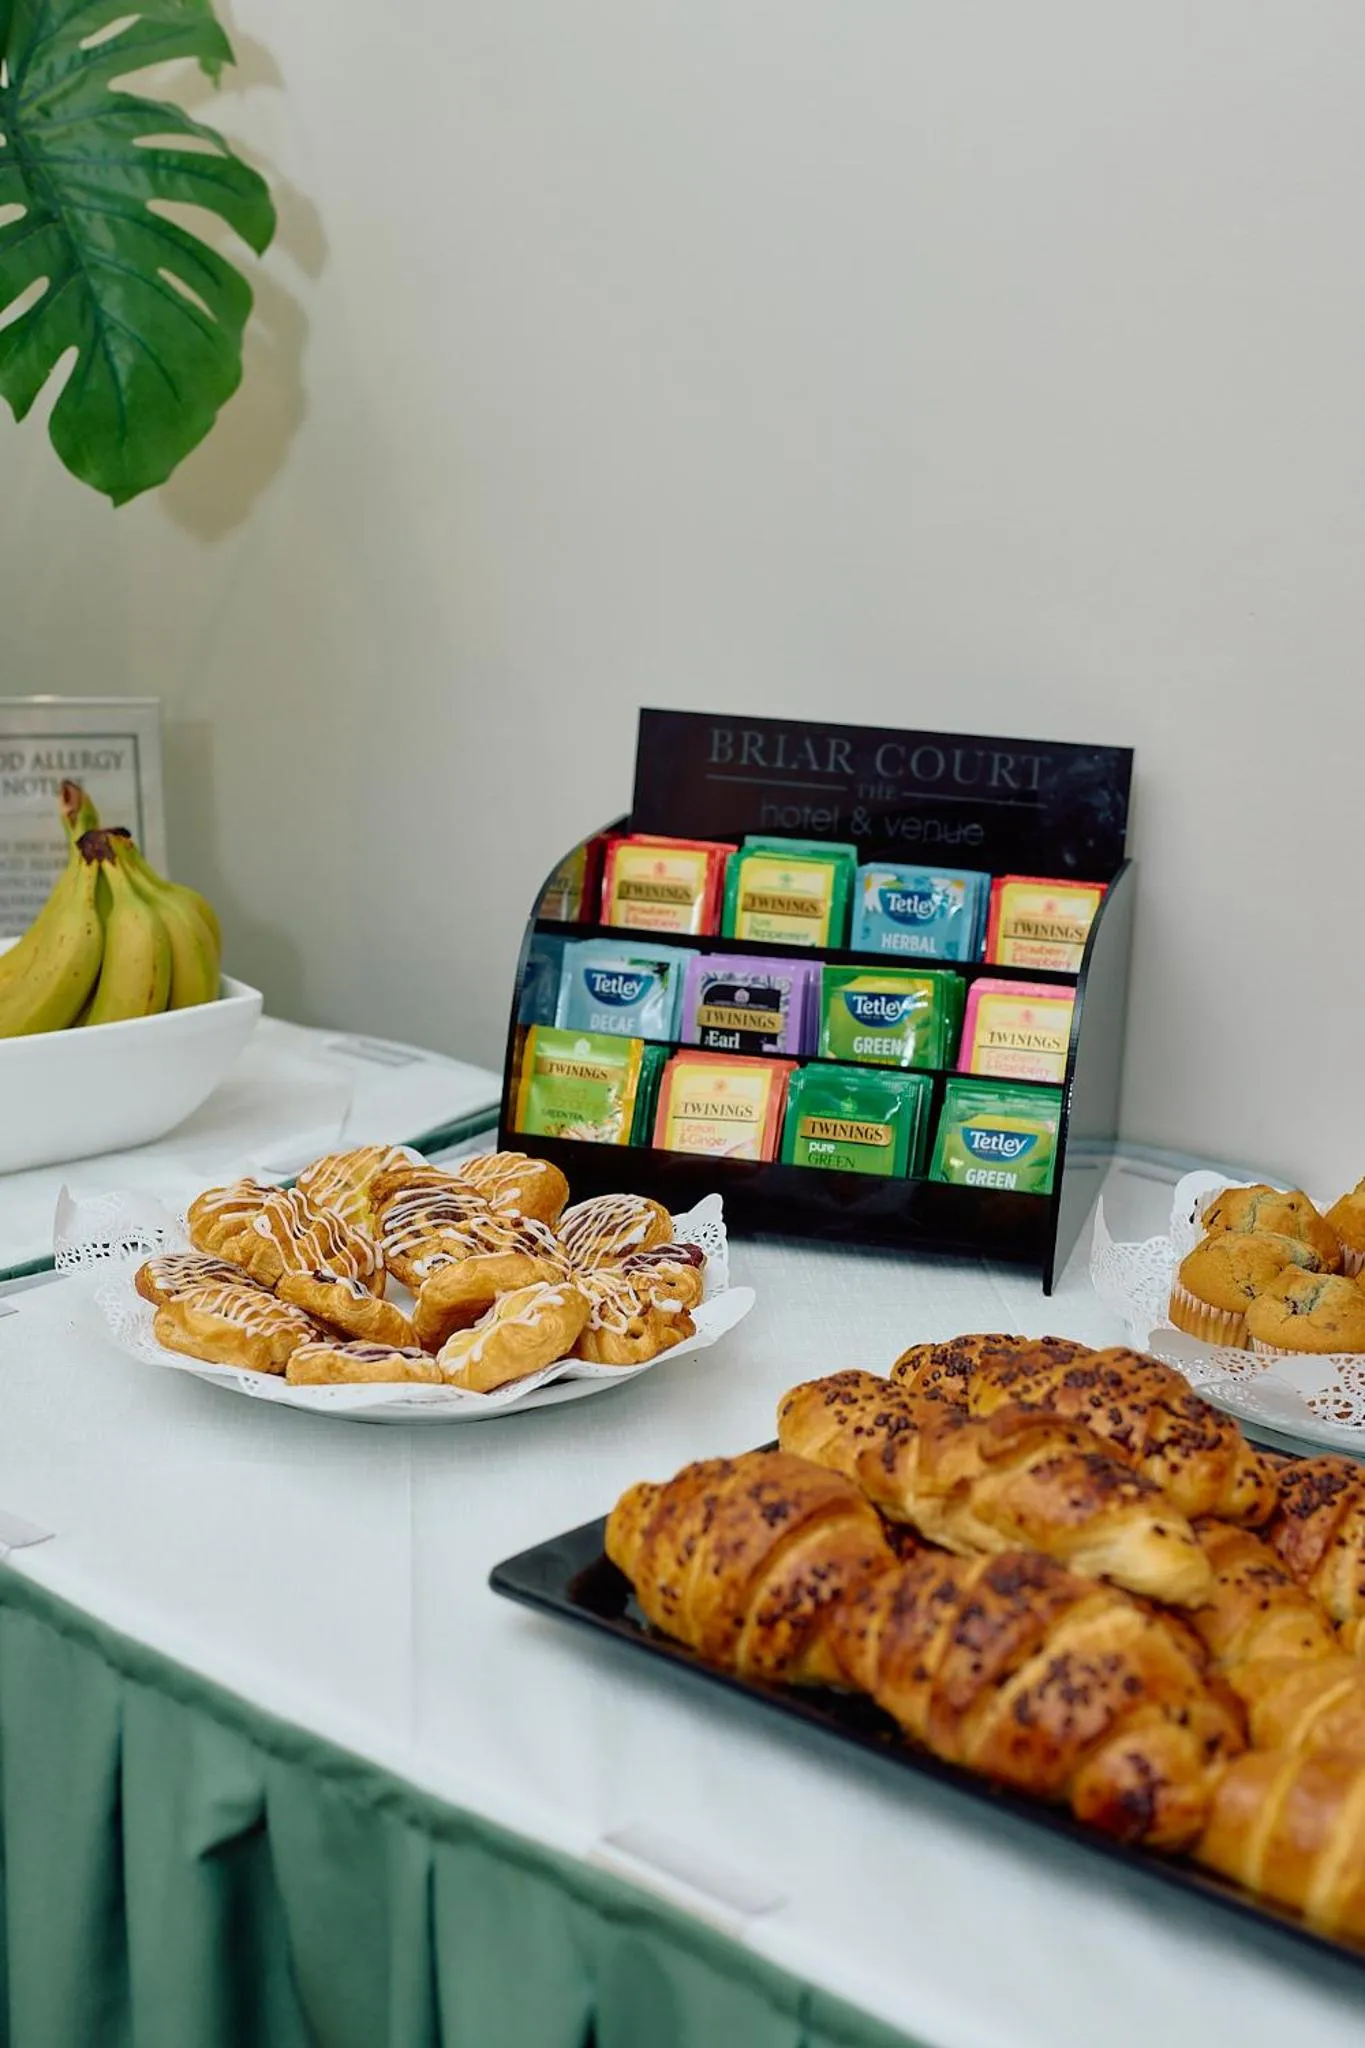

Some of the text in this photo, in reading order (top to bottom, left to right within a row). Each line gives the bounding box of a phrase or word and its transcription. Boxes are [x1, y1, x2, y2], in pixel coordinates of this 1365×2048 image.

[31, 750, 125, 771] ALLERGY
[708, 727, 1051, 790] BRIAR COURT
[3, 776, 83, 798] NOTI
[760, 800, 985, 846] hotel & venue
[622, 880, 693, 902] TWININGS
[749, 894, 819, 914] TWININGS
[887, 892, 937, 920] Tetley
[1013, 921, 1084, 939] TWININGS
[880, 932, 937, 954] HERBAL
[592, 973, 645, 1000] Tetley
[853, 994, 906, 1022] Tetley
[590, 1013, 635, 1033] DECAF
[704, 1009, 777, 1029] TWININGS
[708, 1030, 741, 1049] Earl
[853, 1035, 907, 1057] GREEN
[989, 1031, 1061, 1049] TWININGS
[548, 1062, 609, 1080] TWININGS
[681, 1102, 754, 1117] TWININGS
[681, 1122, 717, 1135] Lemon
[808, 1120, 884, 1142] TWININGS
[808, 1140, 836, 1154] pure
[969, 1130, 1028, 1157] Tetley
[807, 1152, 856, 1169] GREEN
[964, 1167, 1018, 1190] GREEN
